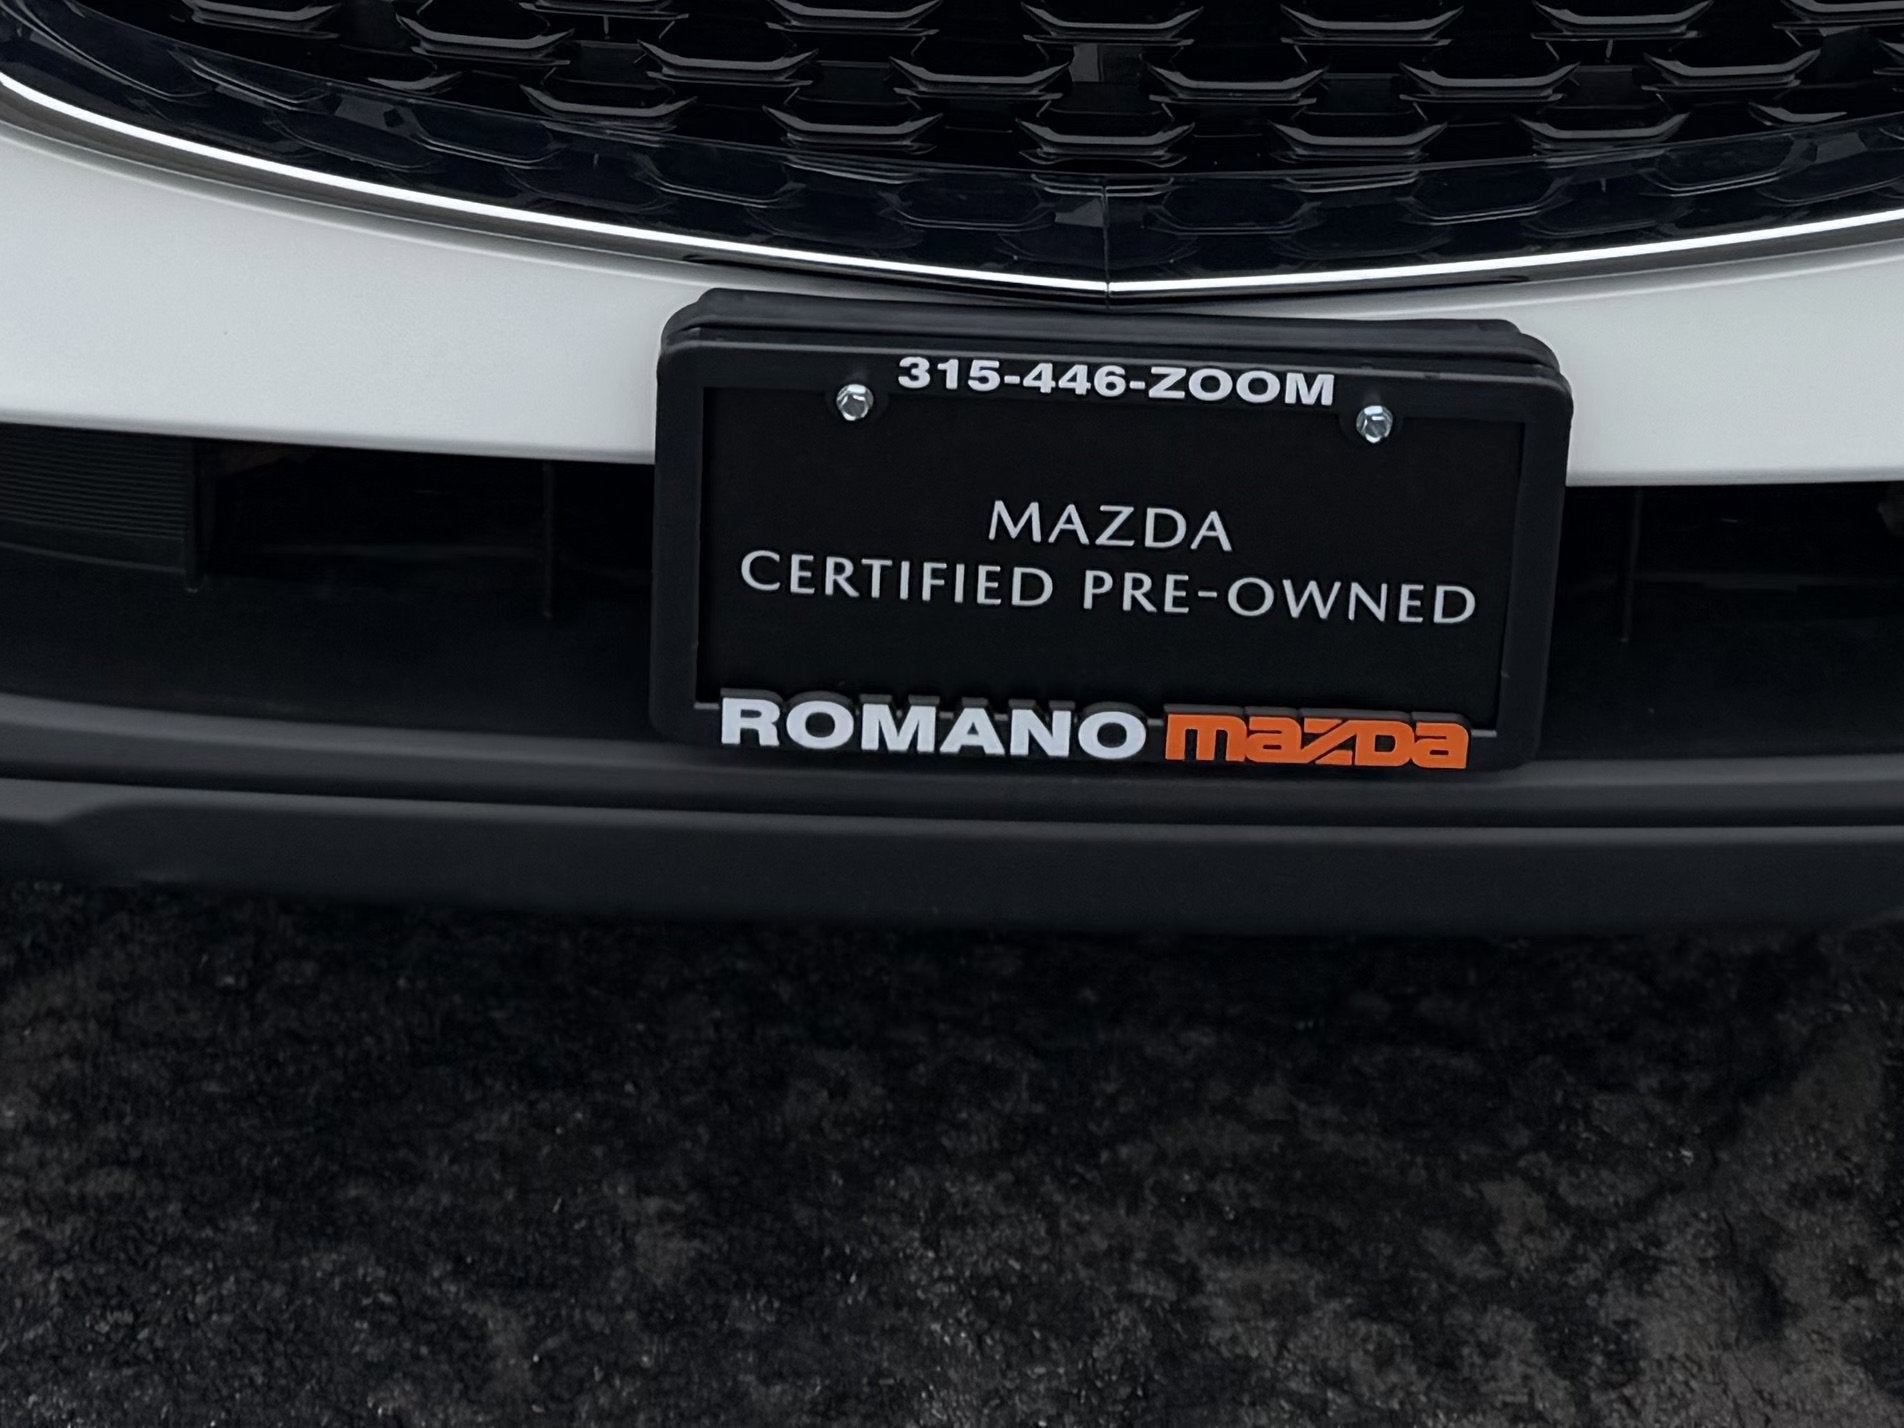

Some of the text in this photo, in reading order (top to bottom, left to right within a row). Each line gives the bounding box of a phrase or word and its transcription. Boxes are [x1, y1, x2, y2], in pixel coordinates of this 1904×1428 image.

[897, 355, 1336, 407] 315-446-ZOOM
[988, 500, 1232, 552] MAZDA
[740, 549, 1477, 625] CERTIFIED PRE-OWNED
[720, 696, 1147, 760] ROMANO
